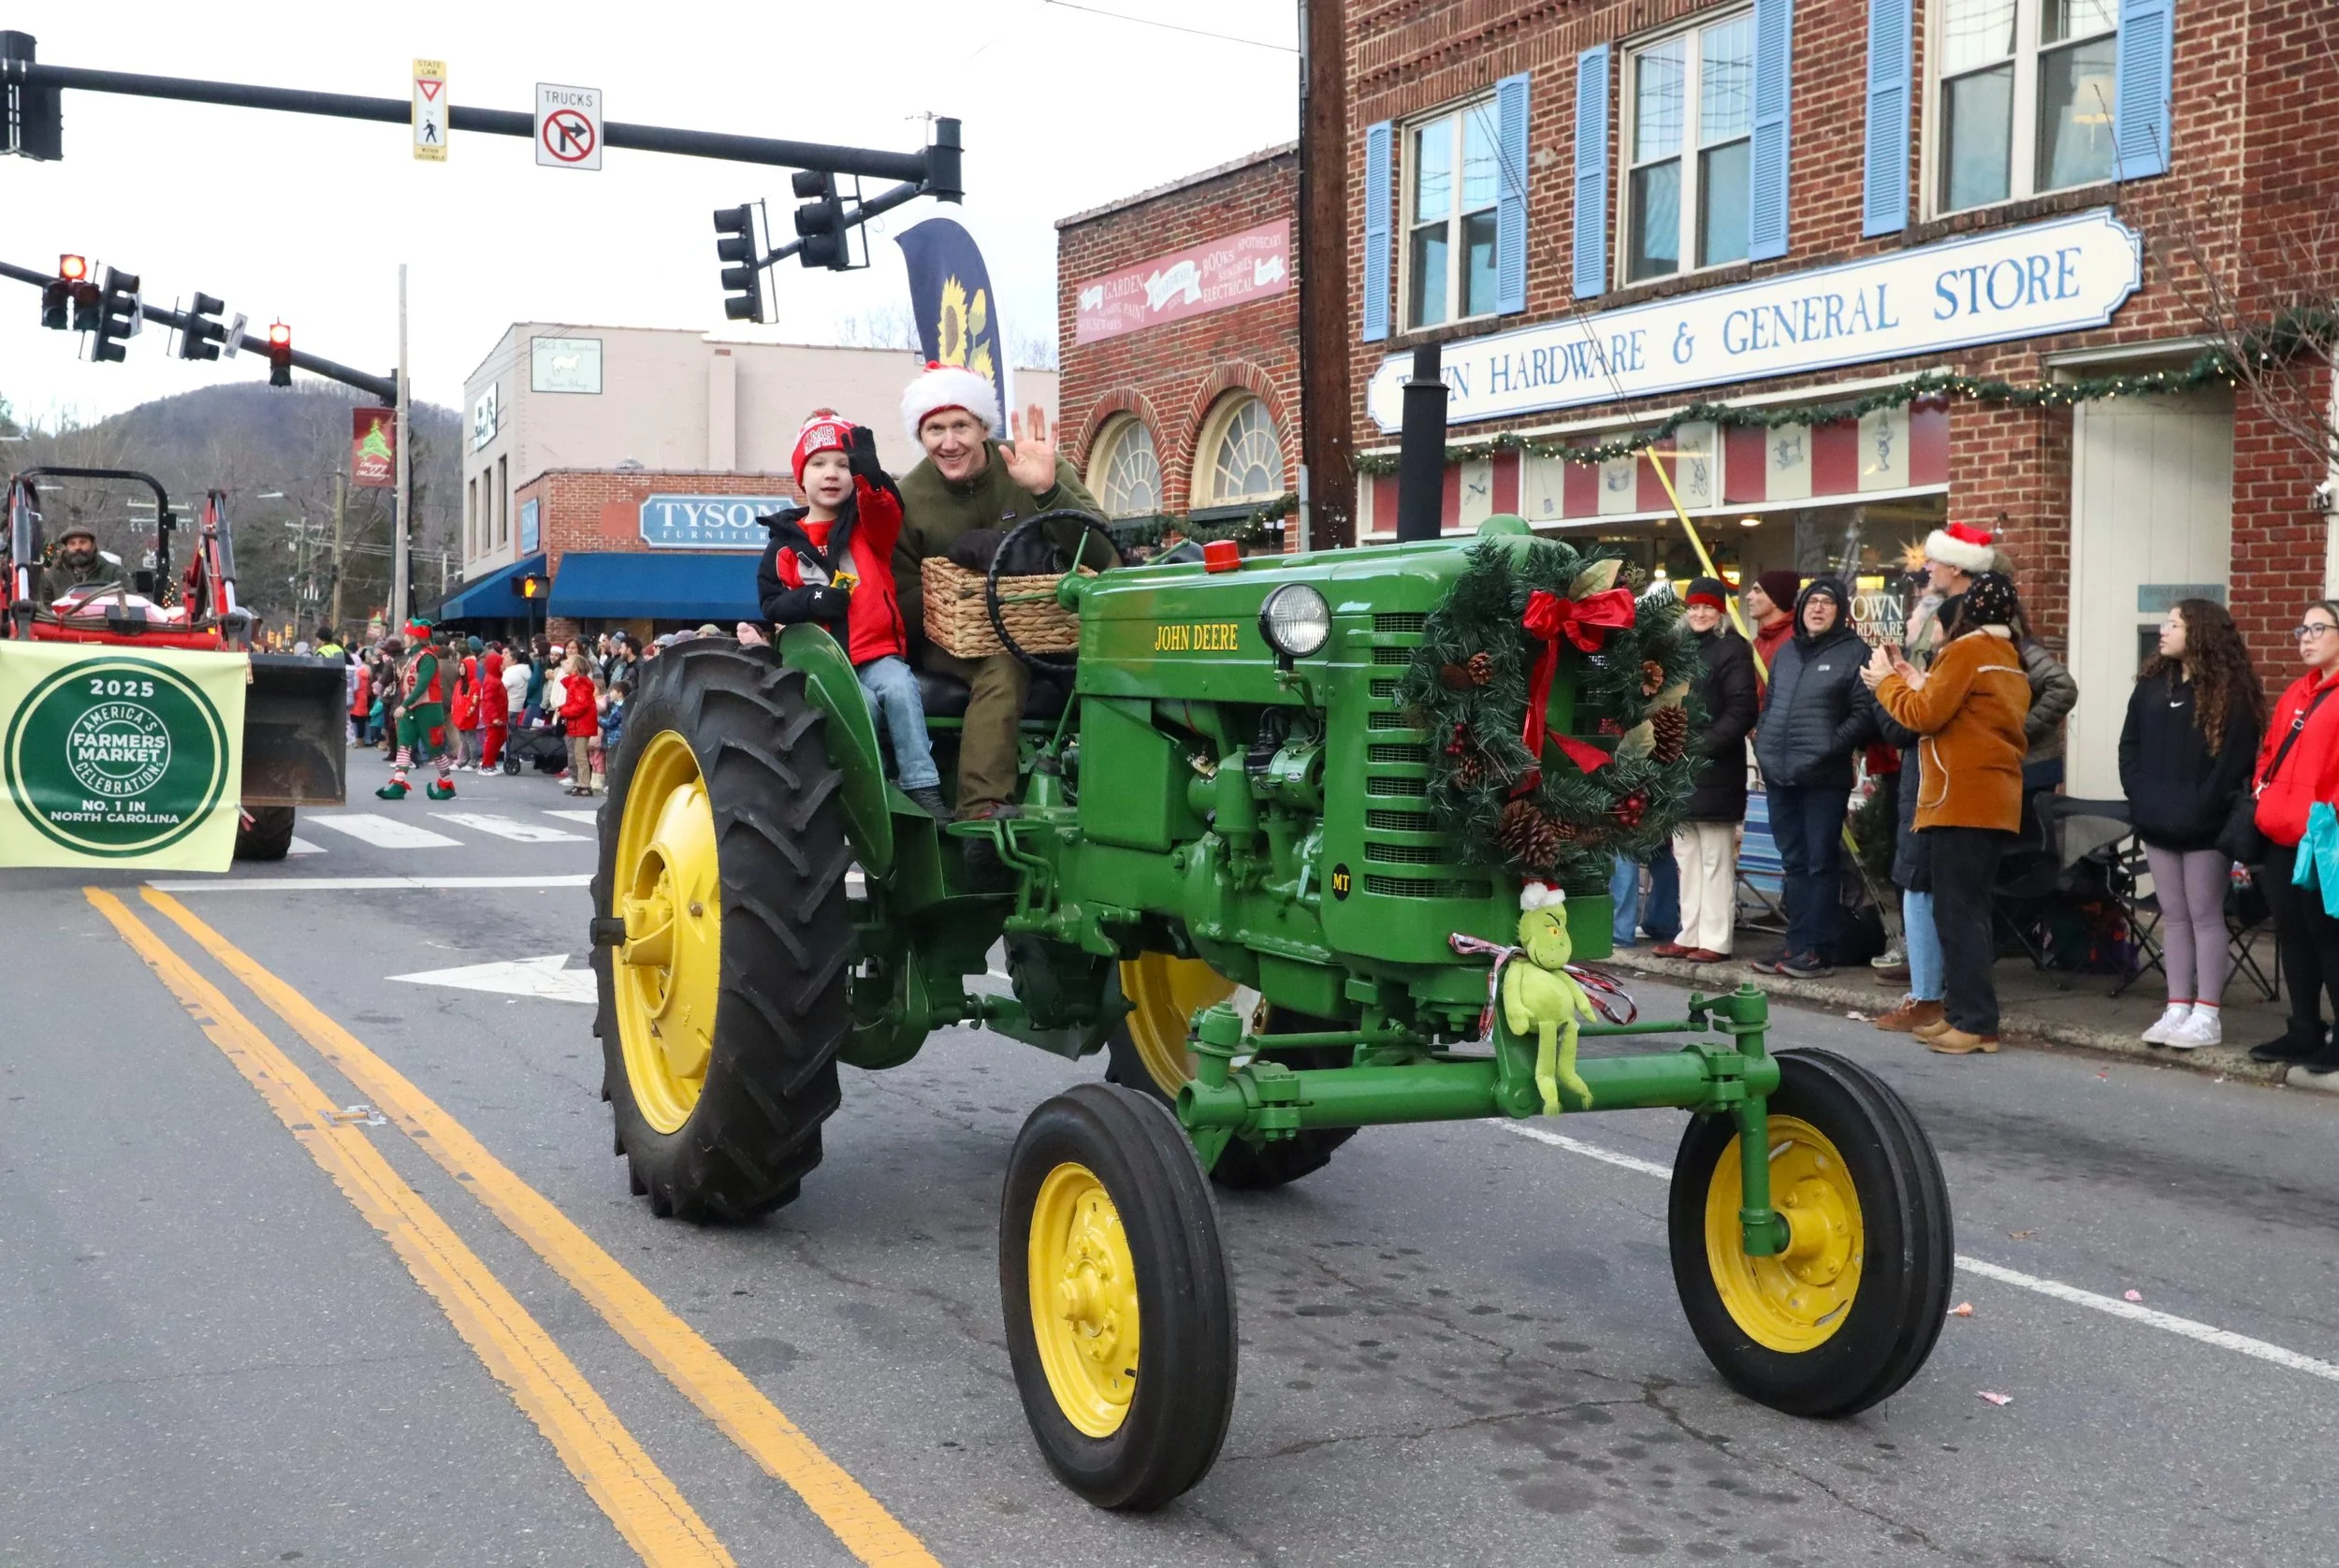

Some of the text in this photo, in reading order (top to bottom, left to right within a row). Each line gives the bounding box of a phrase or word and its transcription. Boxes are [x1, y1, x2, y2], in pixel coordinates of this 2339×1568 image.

[417, 60, 442, 69] STATE
[545, 90, 593, 108] TRUCKS
[1237, 233, 1282, 252] APOTHECARY
[1202, 250, 1235, 279] BOOKS
[1104, 272, 1144, 300] GARDEN
[1202, 277, 1254, 304] ELECTRICAL
[1123, 302, 1146, 323] PAINT
[1396, 246, 2083, 402] TN HARDWARE & GENERAL STORE
[656, 501, 783, 529] TYSON
[662, 530, 767, 541] FURNITUR
[1848, 594, 1905, 622] OWN
[1155, 623, 1239, 651] JOHN DEERE
[1845, 617, 1905, 637] RDWARE
[90, 679, 154, 698] 2025
[82, 705, 157, 733] AMERICA'S
[73, 733, 166, 748] FARMERS
[78, 747, 160, 762] MARKET
[81, 800, 146, 812] NO. 1 IN
[51, 811, 181, 824] NORTH CAROLINA
[1332, 872, 1350, 892] MT
